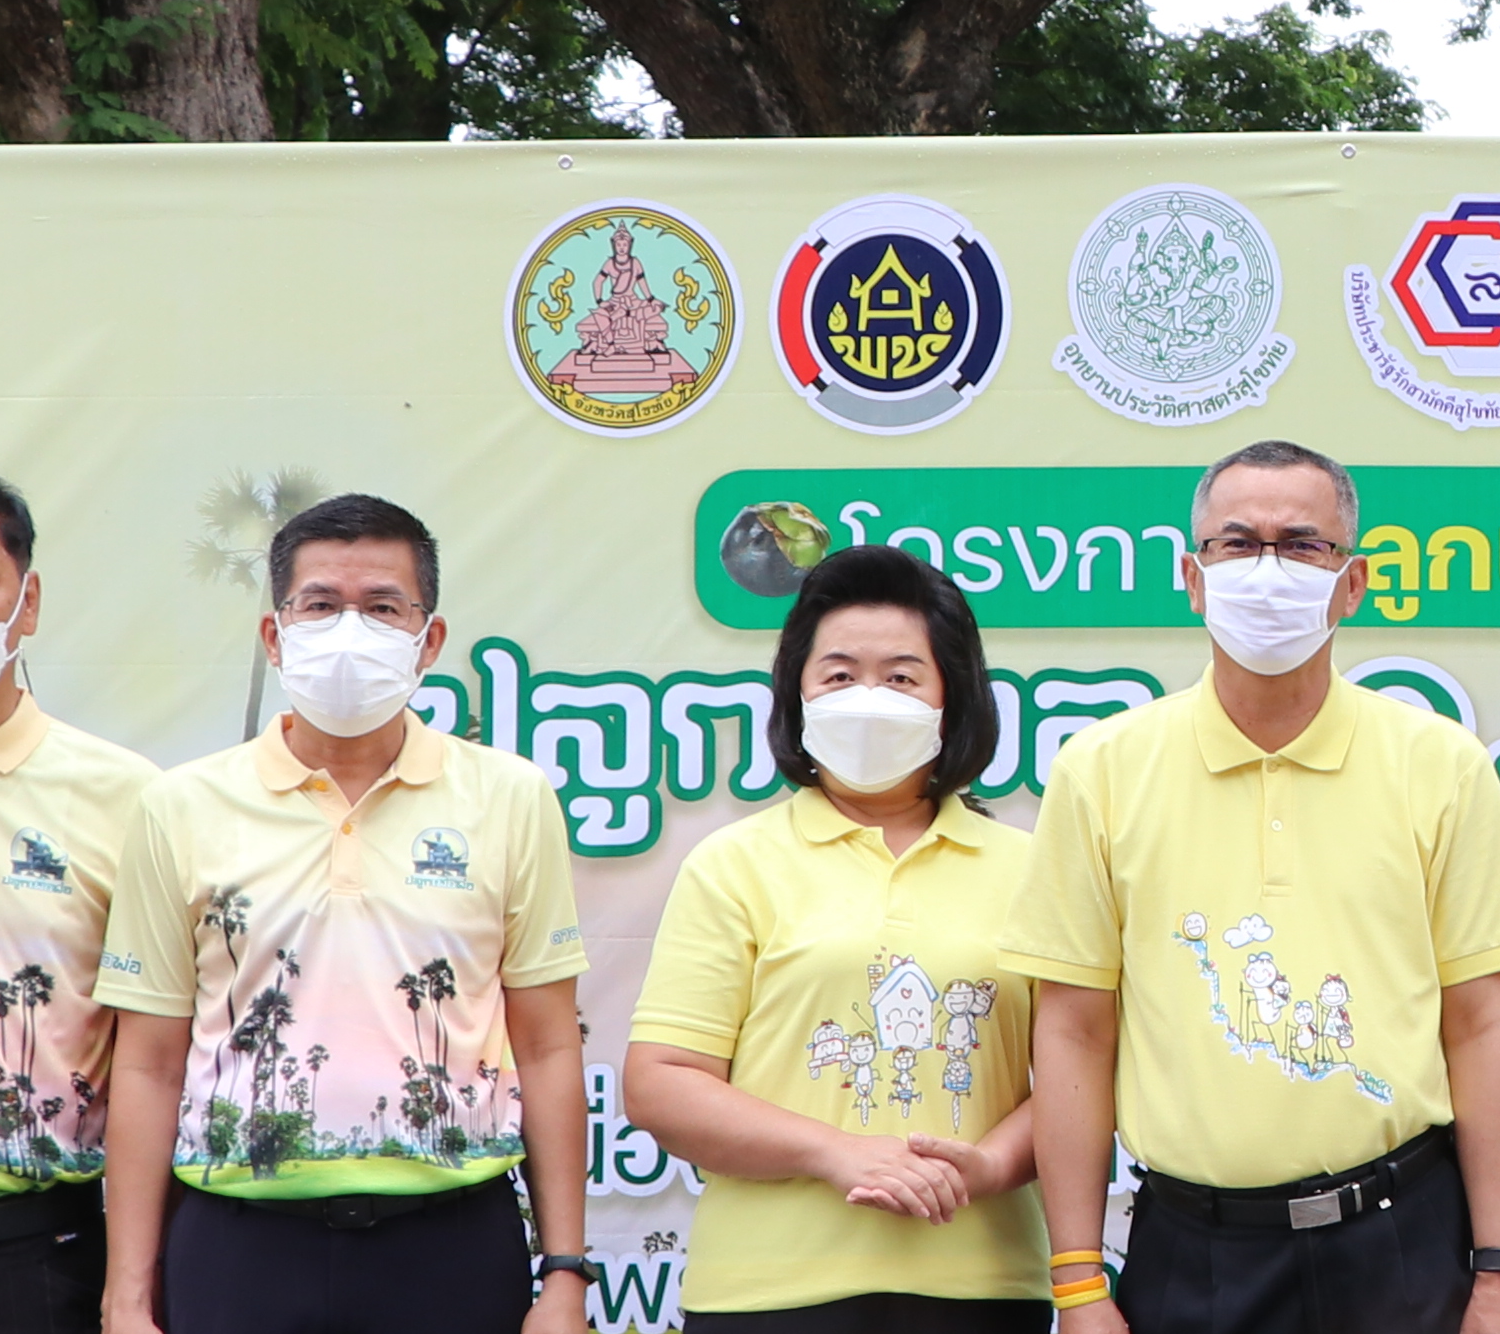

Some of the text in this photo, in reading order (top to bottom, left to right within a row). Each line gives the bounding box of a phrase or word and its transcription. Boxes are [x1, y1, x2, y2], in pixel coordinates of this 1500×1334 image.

[1059, 339, 1289, 419] อุทยานประวัติศาสตร์สุโขทัย
